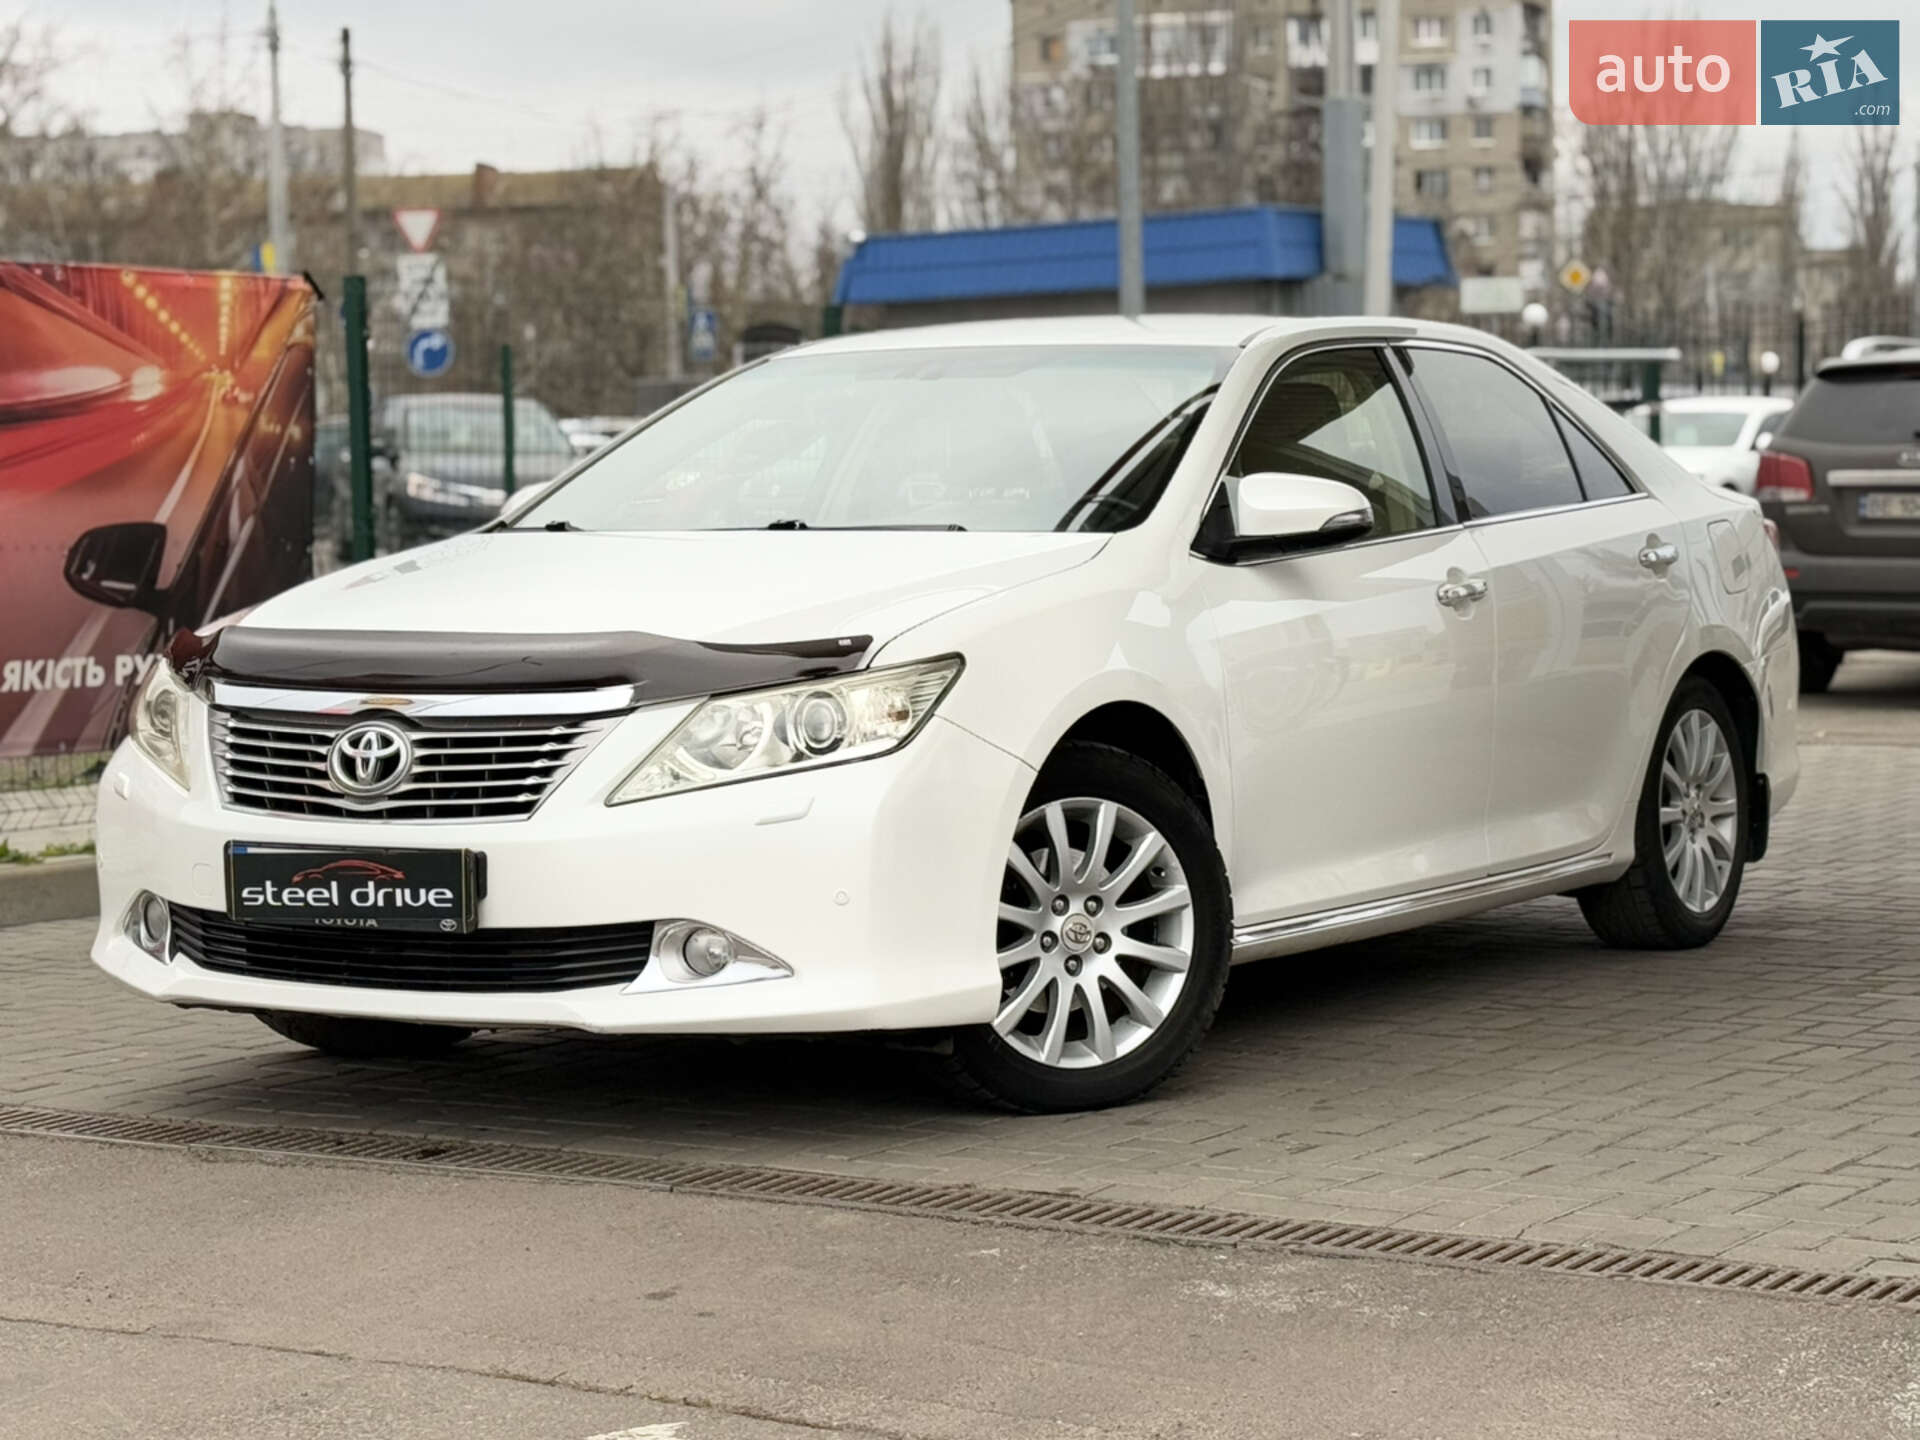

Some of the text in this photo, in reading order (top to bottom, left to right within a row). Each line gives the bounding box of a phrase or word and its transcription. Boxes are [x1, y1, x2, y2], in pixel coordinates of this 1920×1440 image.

[0, 653, 164, 693] ЯКІСТЬ РУ
[241, 880, 454, 907] steel drive
